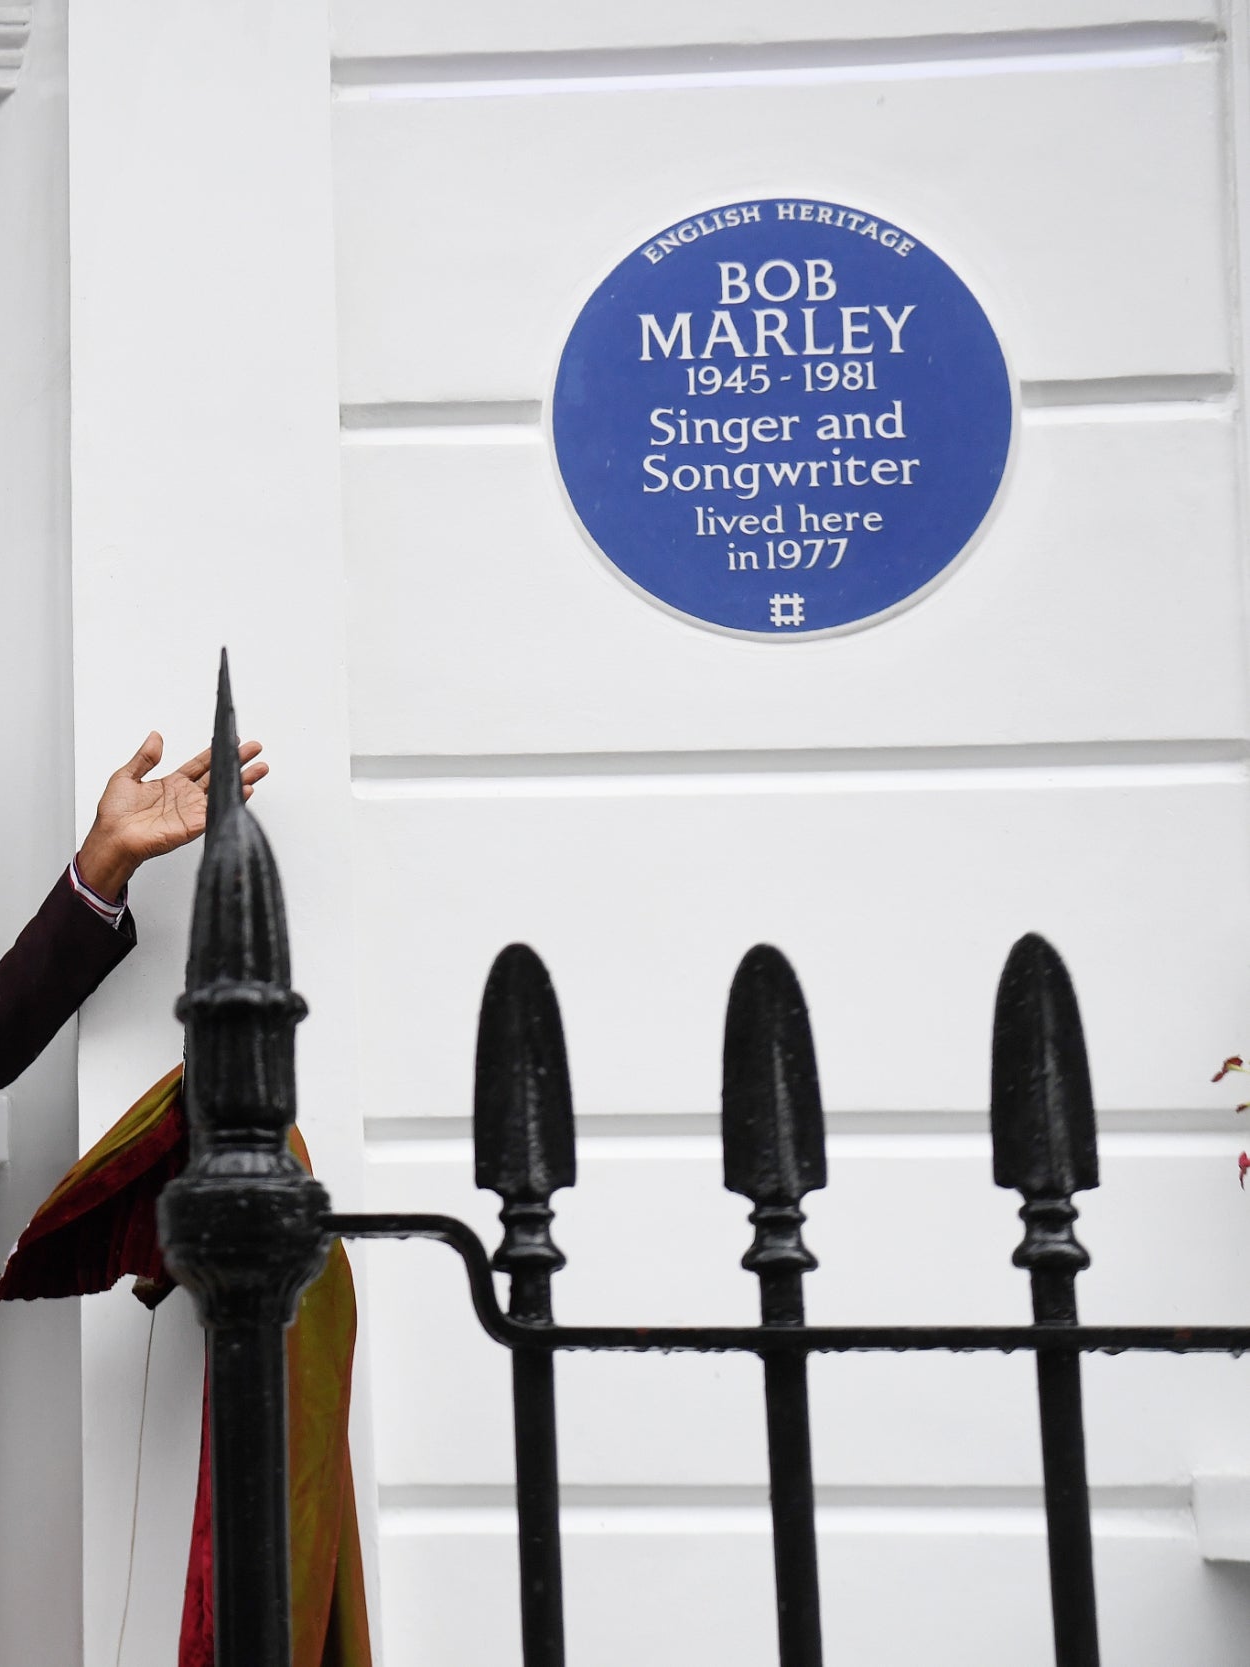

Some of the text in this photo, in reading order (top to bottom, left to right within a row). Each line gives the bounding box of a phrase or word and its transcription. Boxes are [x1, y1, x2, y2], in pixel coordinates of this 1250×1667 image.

[640, 203, 916, 265] ENGLISH HERITAGE
[717, 259, 838, 305] BOB
[638, 304, 917, 361] MARLEY
[649, 400, 906, 454] Singer and
[642, 447, 920, 500] Songwriter
[694, 503, 883, 536] lived here
[727, 537, 848, 571] in 1977
